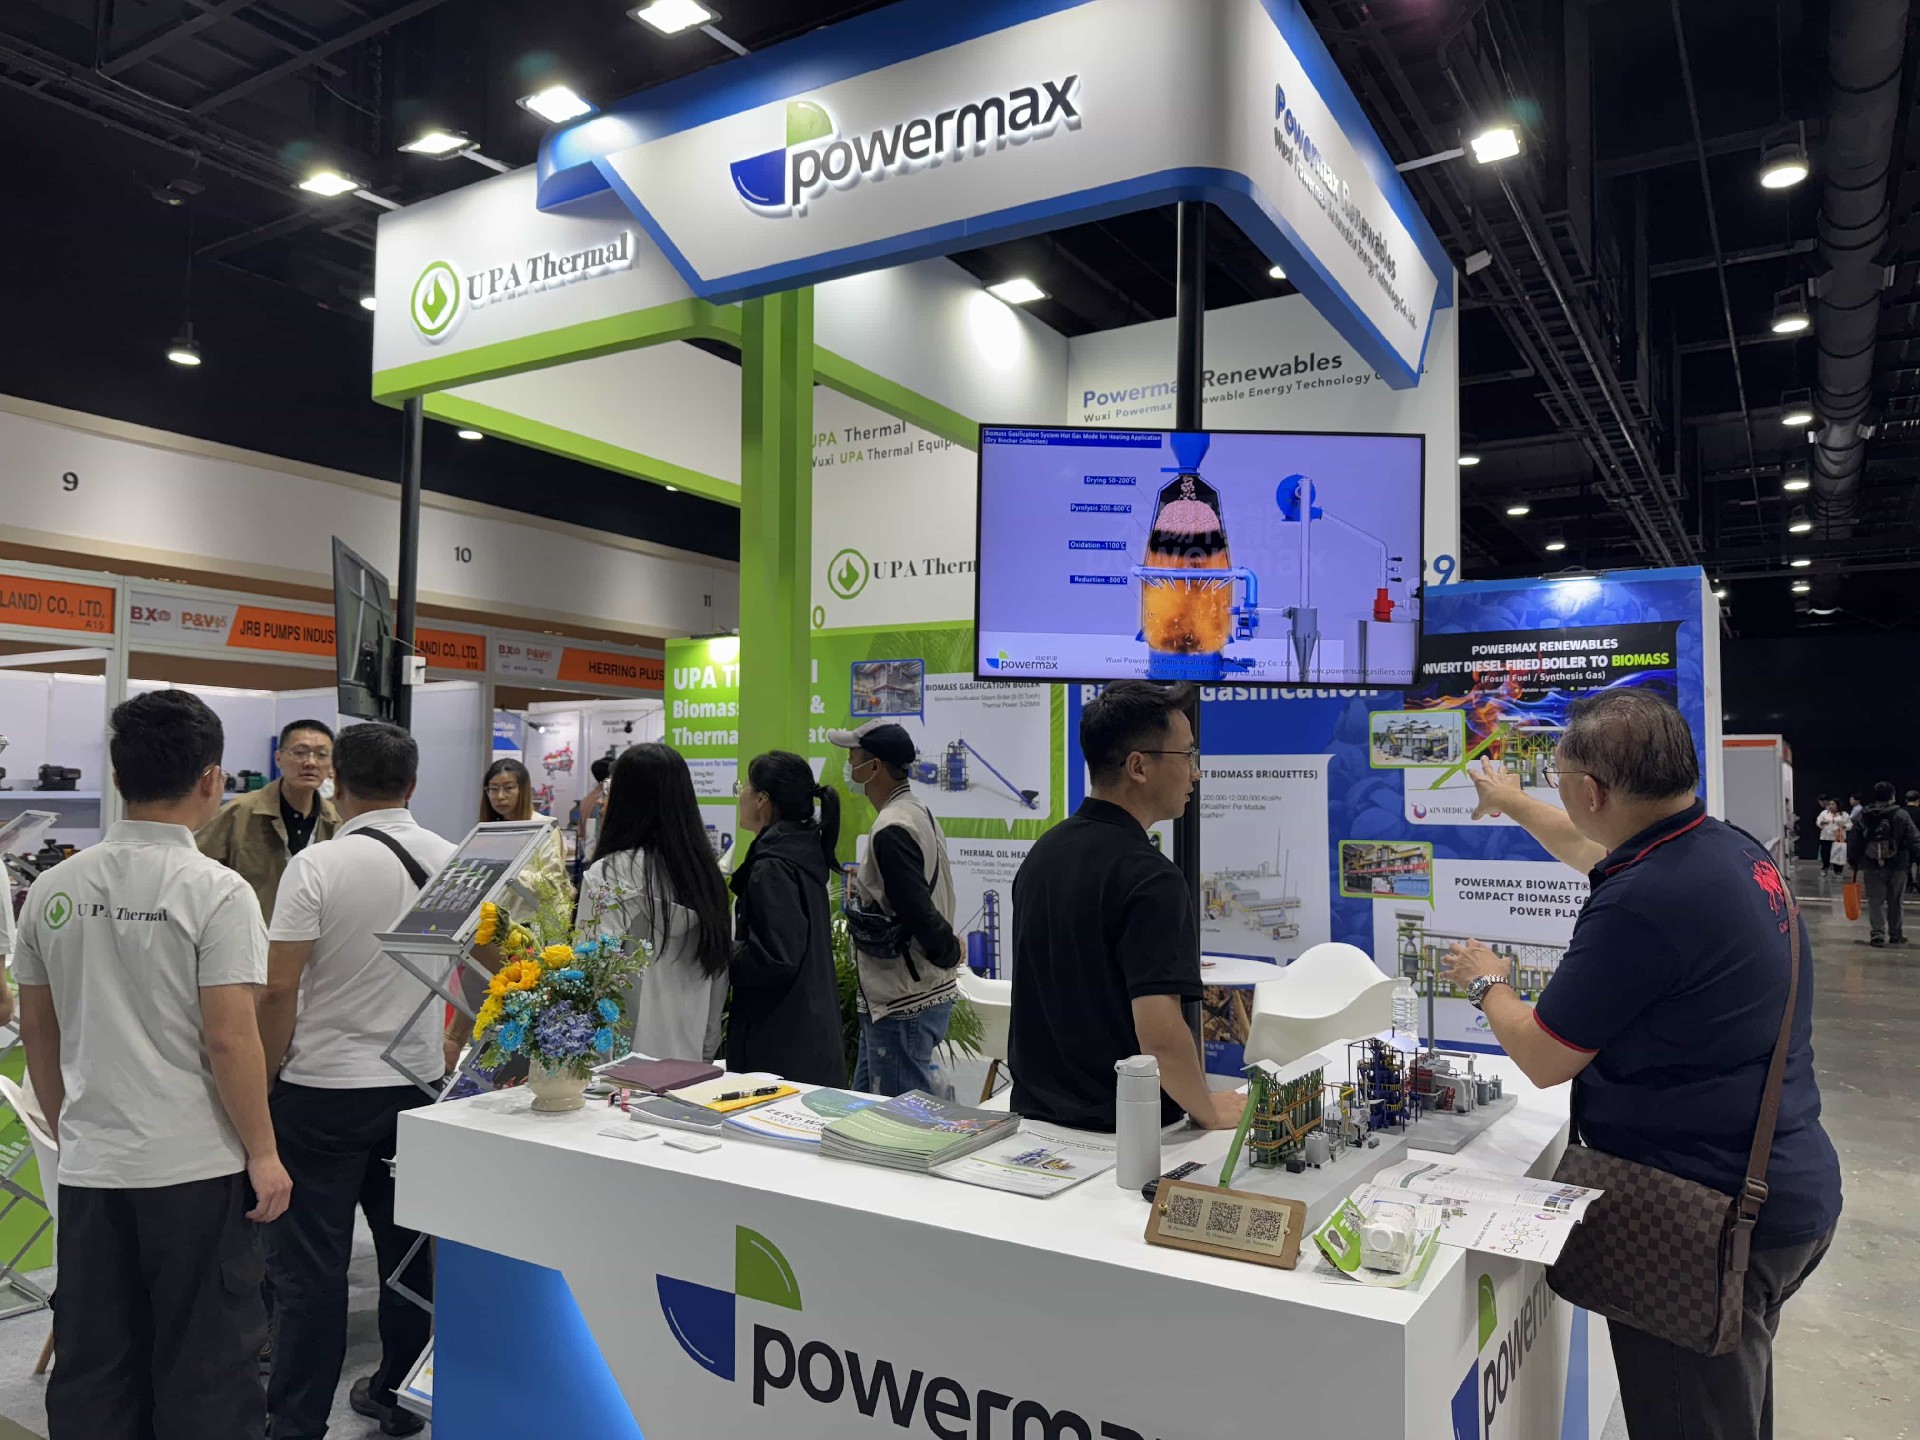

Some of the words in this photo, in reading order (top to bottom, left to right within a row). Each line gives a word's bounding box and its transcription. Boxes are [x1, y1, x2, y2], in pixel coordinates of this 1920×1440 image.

[792, 74, 1079, 206] powermax
[1275, 83, 1339, 201] Powermax
[467, 262, 522, 301] UPA
[527, 231, 630, 284] Thermal
[1083, 376, 1178, 409] Powerma
[1203, 352, 1343, 389] Renewables
[1084, 410, 1111, 423] Wuxi
[1115, 401, 1173, 418] Powermax
[1202, 388, 1245, 405] ewable
[1248, 383, 1293, 399] Energy
[1296, 372, 1371, 391] Technology
[844, 420, 906, 442] Thermal
[840, 451, 864, 464] UPA
[867, 442, 913, 460] Thermal
[62, 471, 79, 491] 9
[1086, 477, 1106, 485] Drying
[454, 546, 472, 563] 10
[873, 562, 918, 580] UPA
[923, 557, 977, 576] Therm
[46, 595, 74, 617] CO.,
[78, 599, 105, 619] LTD.
[240, 620, 261, 637] JRB
[263, 623, 300, 641] PUMPS
[303, 627, 336, 644] INDUS
[443, 643, 461, 659] CO.,
[462, 645, 479, 660] LTD.
[1471, 642, 1537, 656] POWERMAX
[1539, 638, 1618, 651] RENEWABLES
[588, 661, 636, 680] HERRING
[639, 667, 665, 681] PLUS
[1001, 659, 1058, 670] powermax
[1423, 661, 1462, 675] NVERT
[1463, 659, 1505, 673] DIESEL
[1505, 657, 1541, 671] FIRED
[1541, 655, 1587, 670] BOILER
[1589, 655, 1608, 668] TO
[1611, 652, 1670, 667] BIOMASS
[673, 665, 717, 690] UPA
[925, 683, 958, 692] BIOMASS
[959, 681, 1011, 691] GASIFICATION
[1480, 674, 1510, 684] (Fossil
[1512, 673, 1531, 682] Fuel
[1540, 671, 1584, 683] Synthesis
[1585, 670, 1606, 681] Gas)
[673, 699, 739, 718] Biomas
[810, 695, 825, 714] &
[672, 726, 739, 745] Therma
[1211, 770, 1253, 778] BIOMASS
[1256, 769, 1318, 779] BRIQUETTES)
[1442, 806, 1474, 815] MEDICAR
[960, 849, 994, 858] THERMAL
[996, 850, 1009, 858] OIL
[1011, 850, 1029, 858] HEA
[1454, 877, 1522, 889] POWERMAX
[1458, 890, 1513, 902] COMPACT
[1517, 892, 1571, 904] BIOMASS
[1509, 906, 1552, 917] POWER
[1555, 908, 1580, 918] PLA
[765, 1108, 803, 1121] ZERO
[1483, 1270, 1557, 1440] powerm
[754, 1323, 1160, 1440] powerm
